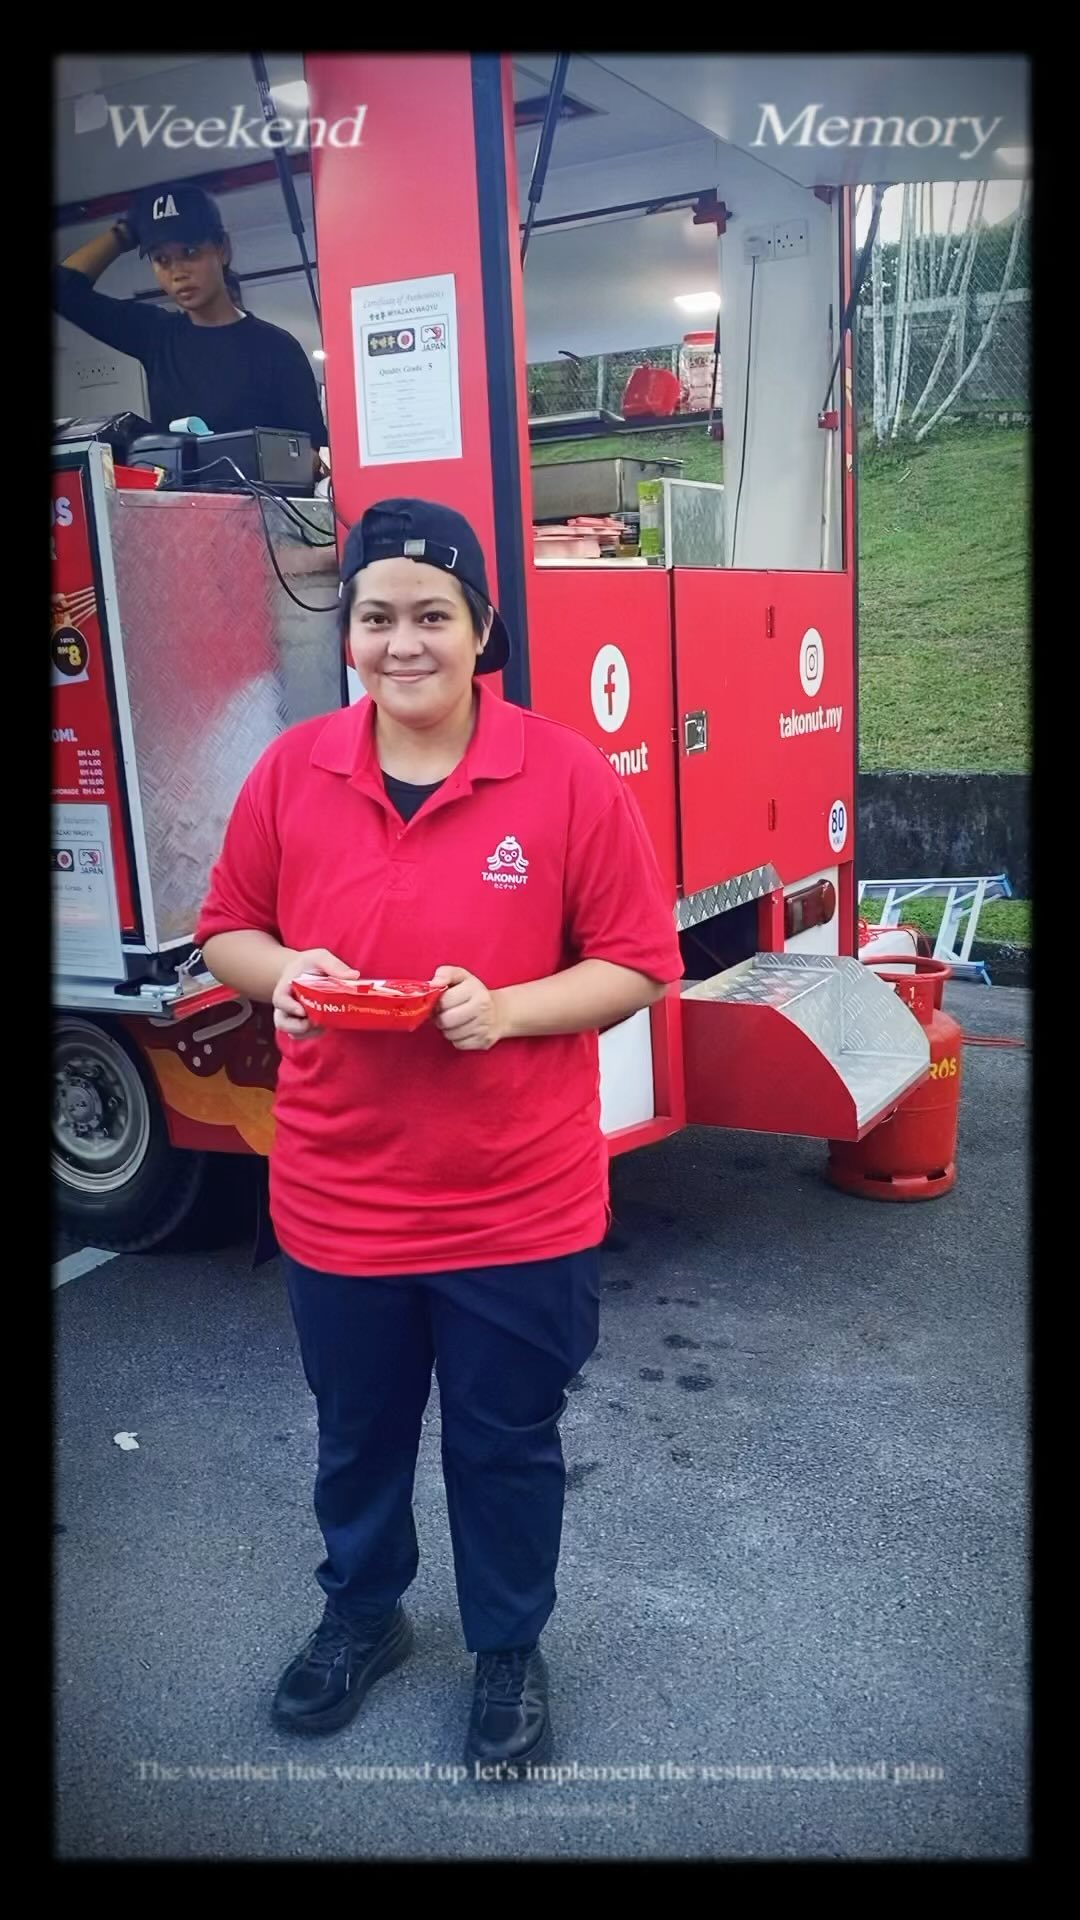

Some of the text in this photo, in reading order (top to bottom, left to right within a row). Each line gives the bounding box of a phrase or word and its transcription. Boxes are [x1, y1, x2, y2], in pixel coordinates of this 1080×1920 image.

[153, 194, 180, 220] CA
[387, 304, 439, 316] MIYAZAKI WAGYU
[422, 342, 447, 352] JAPAN
[68, 645, 82, 666] 8
[779, 705, 843, 738] takonut.my
[831, 807, 845, 834] 80
[481, 872, 528, 884] TAKONUT
[323, 1003, 345, 1013] No.1
